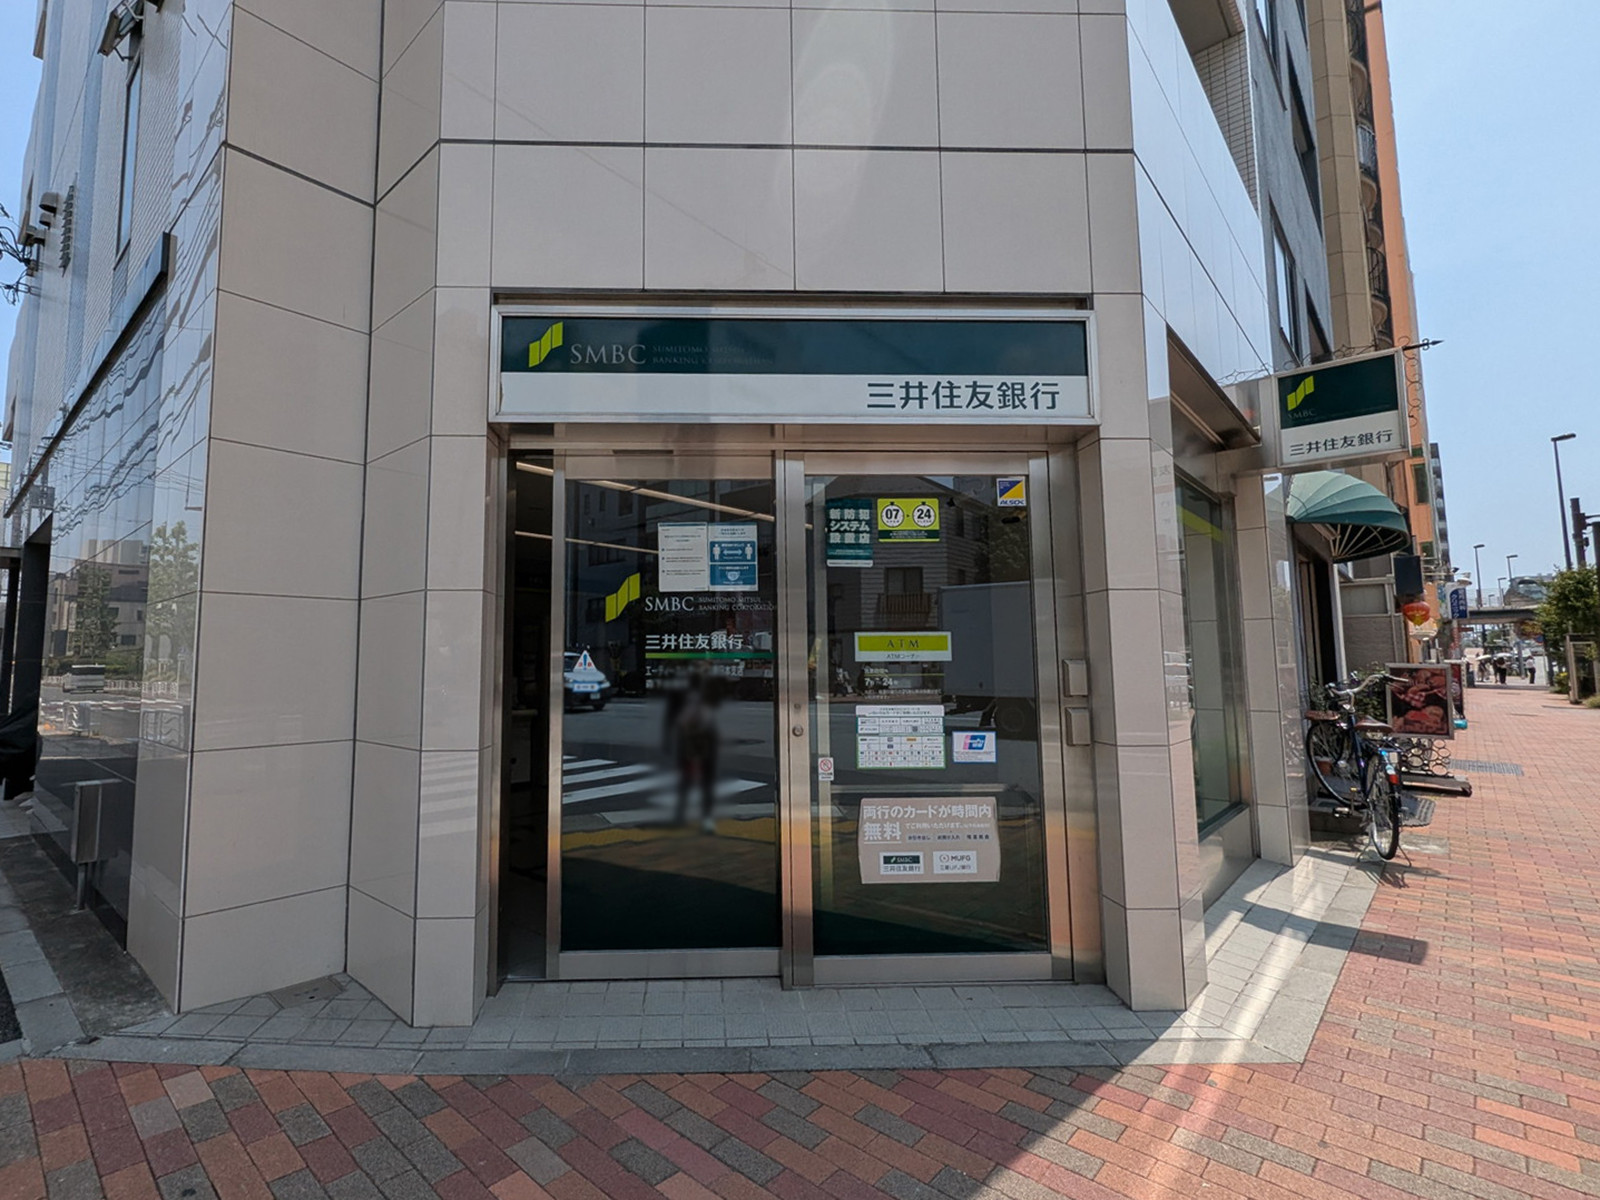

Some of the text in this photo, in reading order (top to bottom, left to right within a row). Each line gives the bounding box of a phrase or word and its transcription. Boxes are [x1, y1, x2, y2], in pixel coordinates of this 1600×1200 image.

[570, 343, 646, 364] SMBC
[867, 380, 1060, 410] 三井住友銀行
[1290, 429, 1393, 457] 三井住友銀行
[829, 508, 870, 520] 新防犯
[885, 508, 932, 520] 07 24
[830, 520, 870, 532] システム
[645, 596, 694, 612] SMBC
[645, 633, 743, 650] 三井住友銀行
[887, 639, 920, 649] ATM
[863, 804, 992, 819] 両行のカードが時間内
[864, 821, 902, 841] 無料
[950, 854, 971, 863] MUFG
